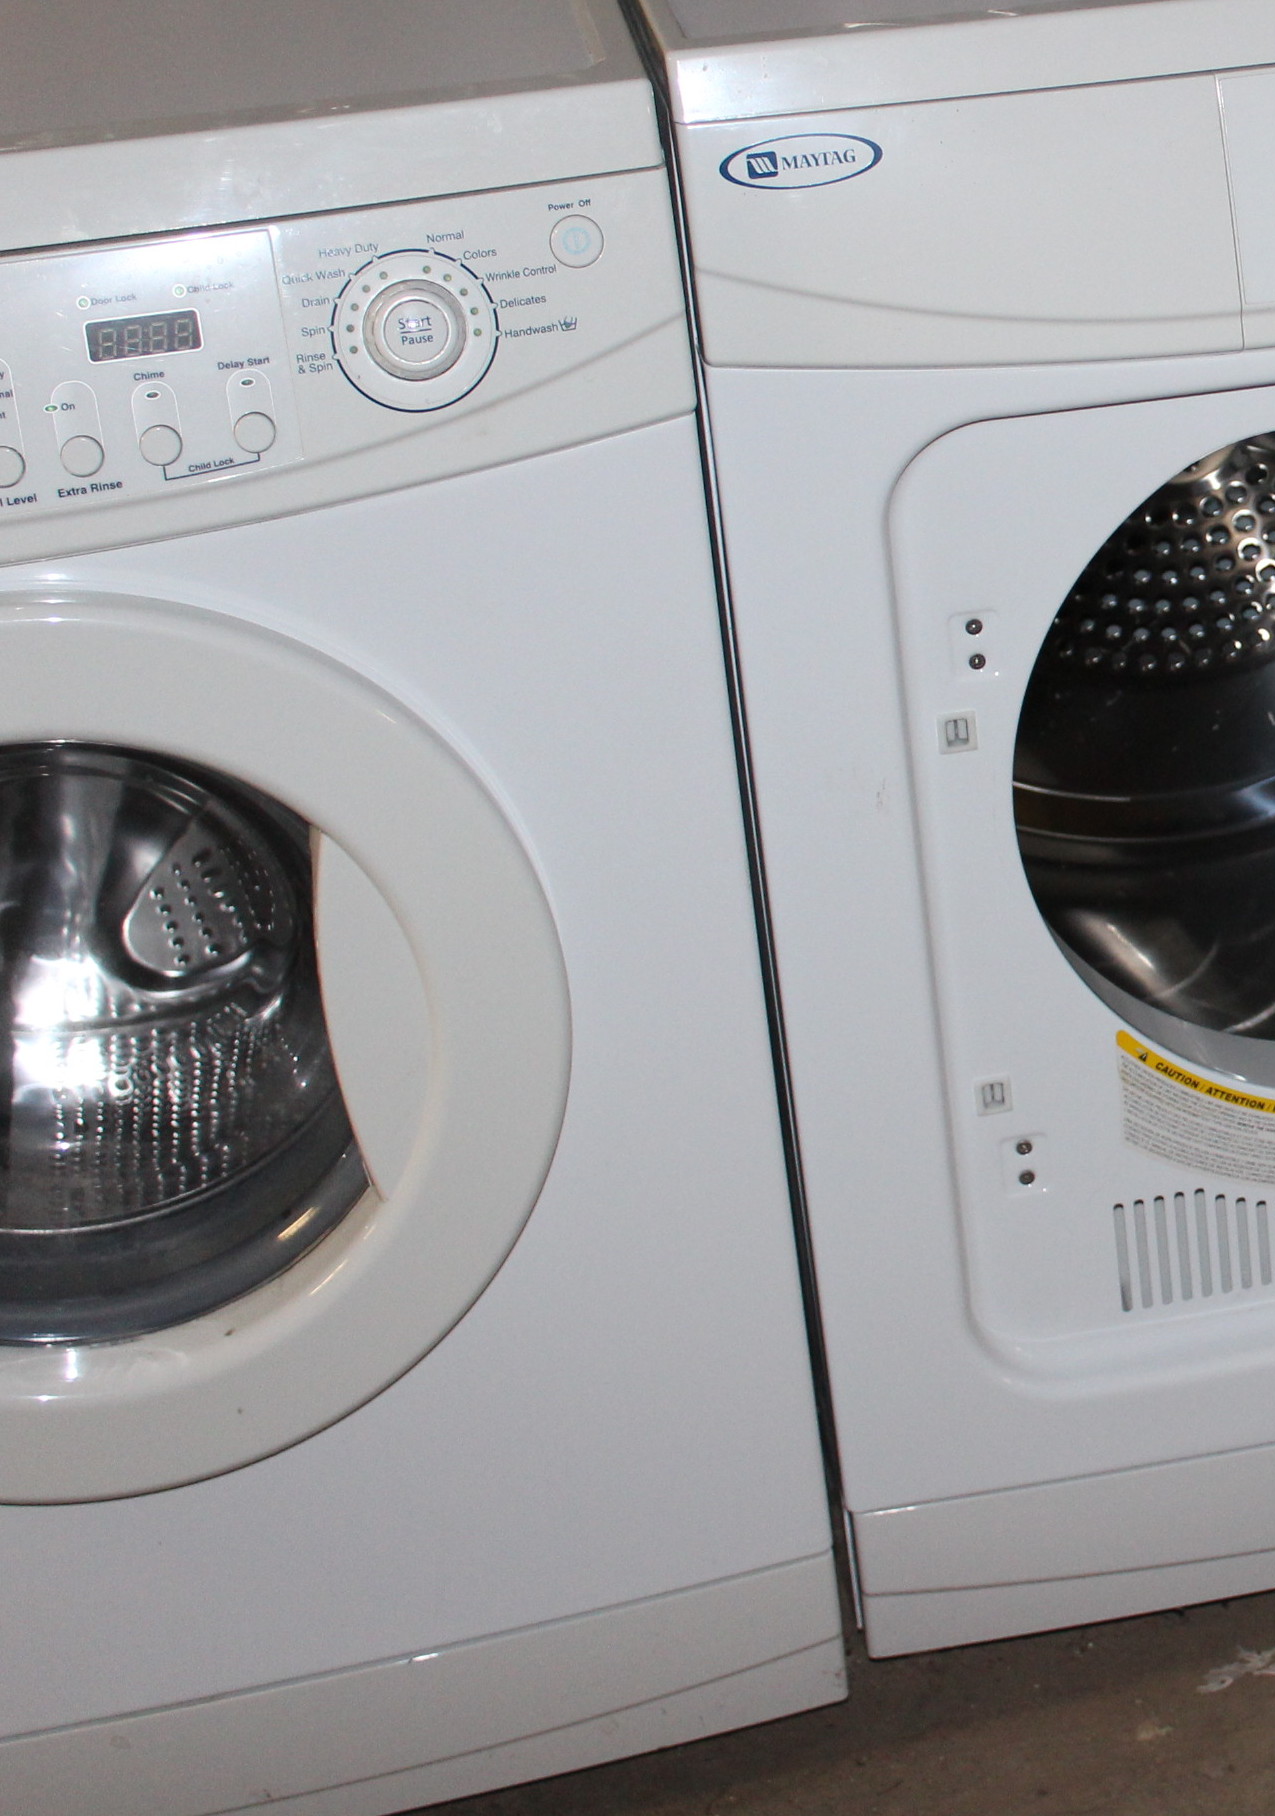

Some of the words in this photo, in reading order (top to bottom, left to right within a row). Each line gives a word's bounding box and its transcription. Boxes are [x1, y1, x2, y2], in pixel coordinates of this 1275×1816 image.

[781, 149, 856, 171] MAYTAG
[547, 201, 574, 212] Power
[578, 199, 591, 208] Off
[426, 230, 465, 244] Normal
[318, 245, 351, 259] Heavy
[354, 242, 379, 255] Duty
[463, 247, 497, 261] Colors
[282, 272, 313, 286] Quick
[315, 268, 346, 282] Wash
[485, 269, 520, 283] Wrinkle
[522, 264, 557, 278] Control
[213, 281, 234, 291] Lock
[91, 297, 113, 307] Door
[115, 293, 137, 303] Lock
[301, 296, 330, 309] Drain
[499, 294, 547, 309] Delicates
[301, 325, 326, 339] Spin
[504, 322, 559, 339] Handwash
[401, 334, 434, 346] Pause
[217, 359, 245, 371] Delay
[247, 356, 270, 367] Start
[296, 351, 326, 364] Rinse
[298, 365, 306, 375] &
[308, 361, 333, 375] Spin
[133, 370, 165, 382] Chime
[60, 402, 76, 411] On
[188, 461, 212, 473] Child
[213, 457, 235, 469] Lock
[57, 486, 88, 499] Extra
[90, 480, 123, 493] Rinse
[7, 493, 38, 506] Level
[1155, 1062, 1200, 1088] CAUTION
[1205, 1086, 1265, 1111] ATTENTION
